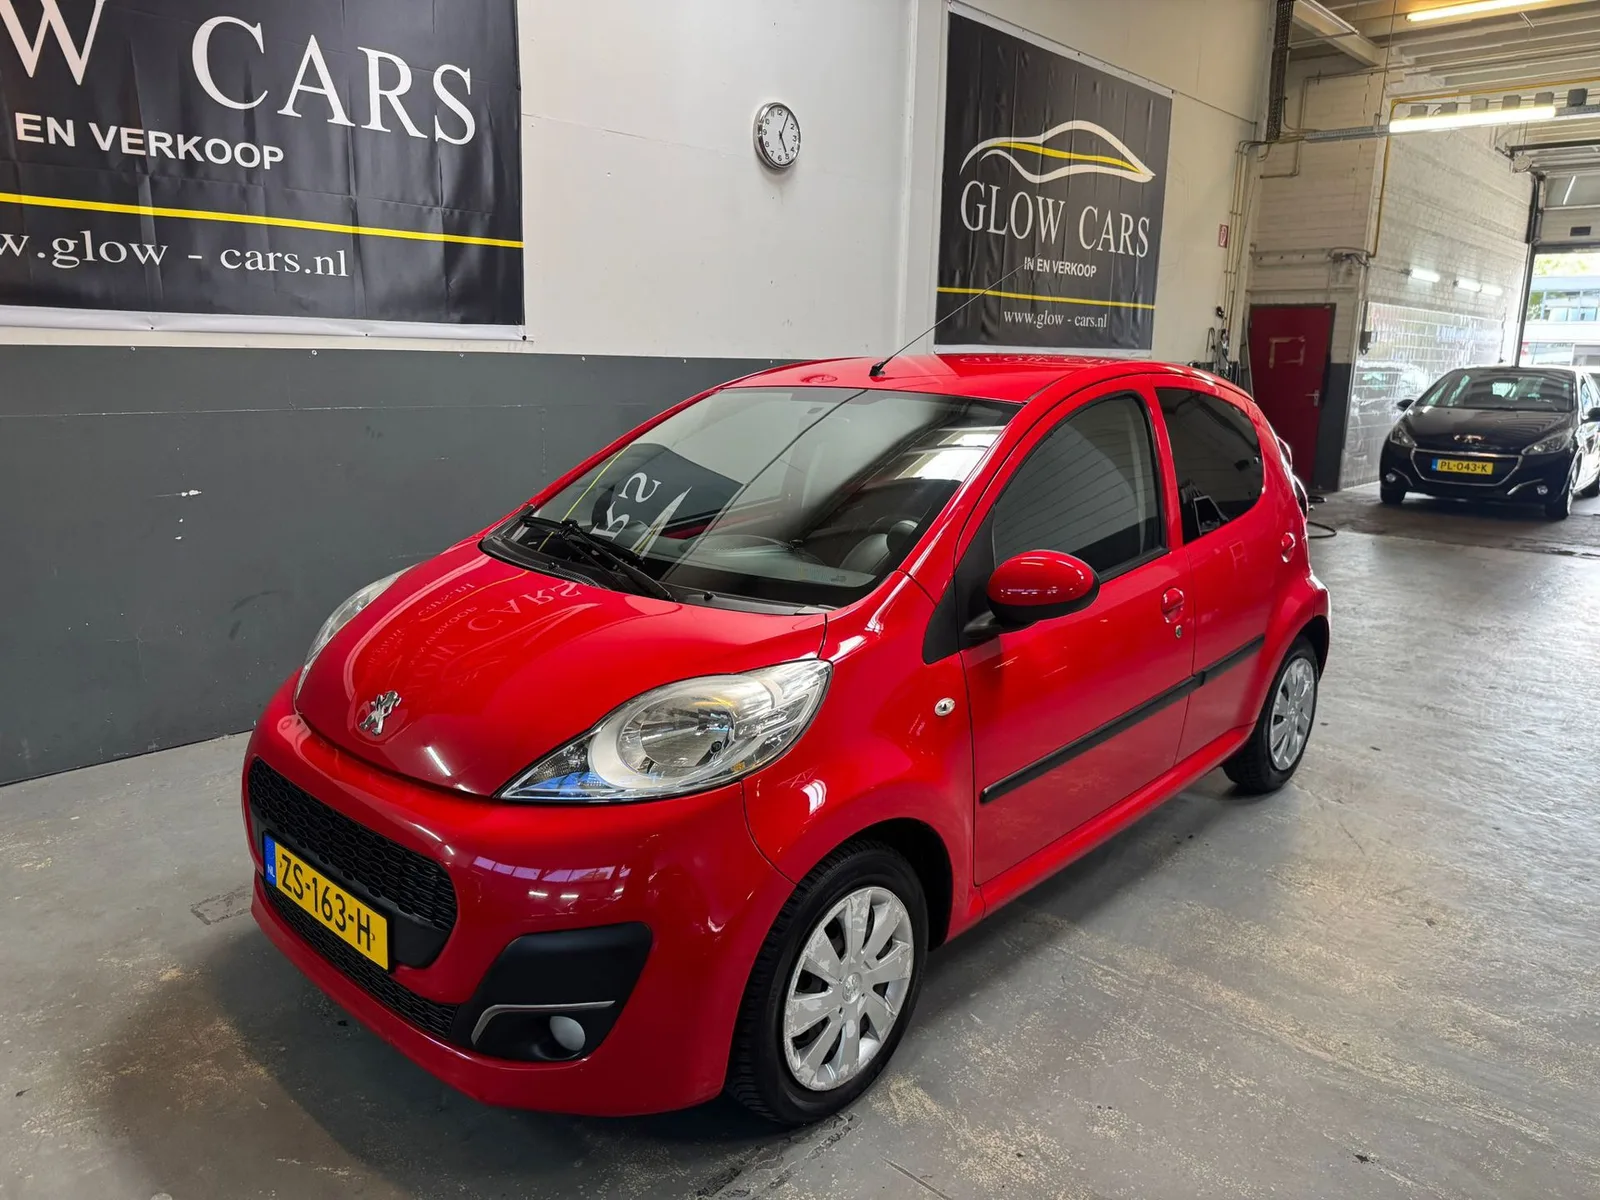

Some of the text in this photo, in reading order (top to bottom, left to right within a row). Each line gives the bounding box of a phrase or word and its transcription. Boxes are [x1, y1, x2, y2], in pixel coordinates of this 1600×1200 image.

[191, 15, 477, 145] CARS
[15, 112, 285, 171] EN VERKOOP
[960, 180, 1150, 258] GLOW CARS
[220, 248, 350, 277] cars.nl
[1023, 256, 1097, 278] IN EN VERKOOP
[1003, 309, 1064, 329] www.glow
[1074, 313, 1108, 328] cars.nl
[267, 864, 275, 878] NL
[281, 853, 371, 951] ZS-163-H
